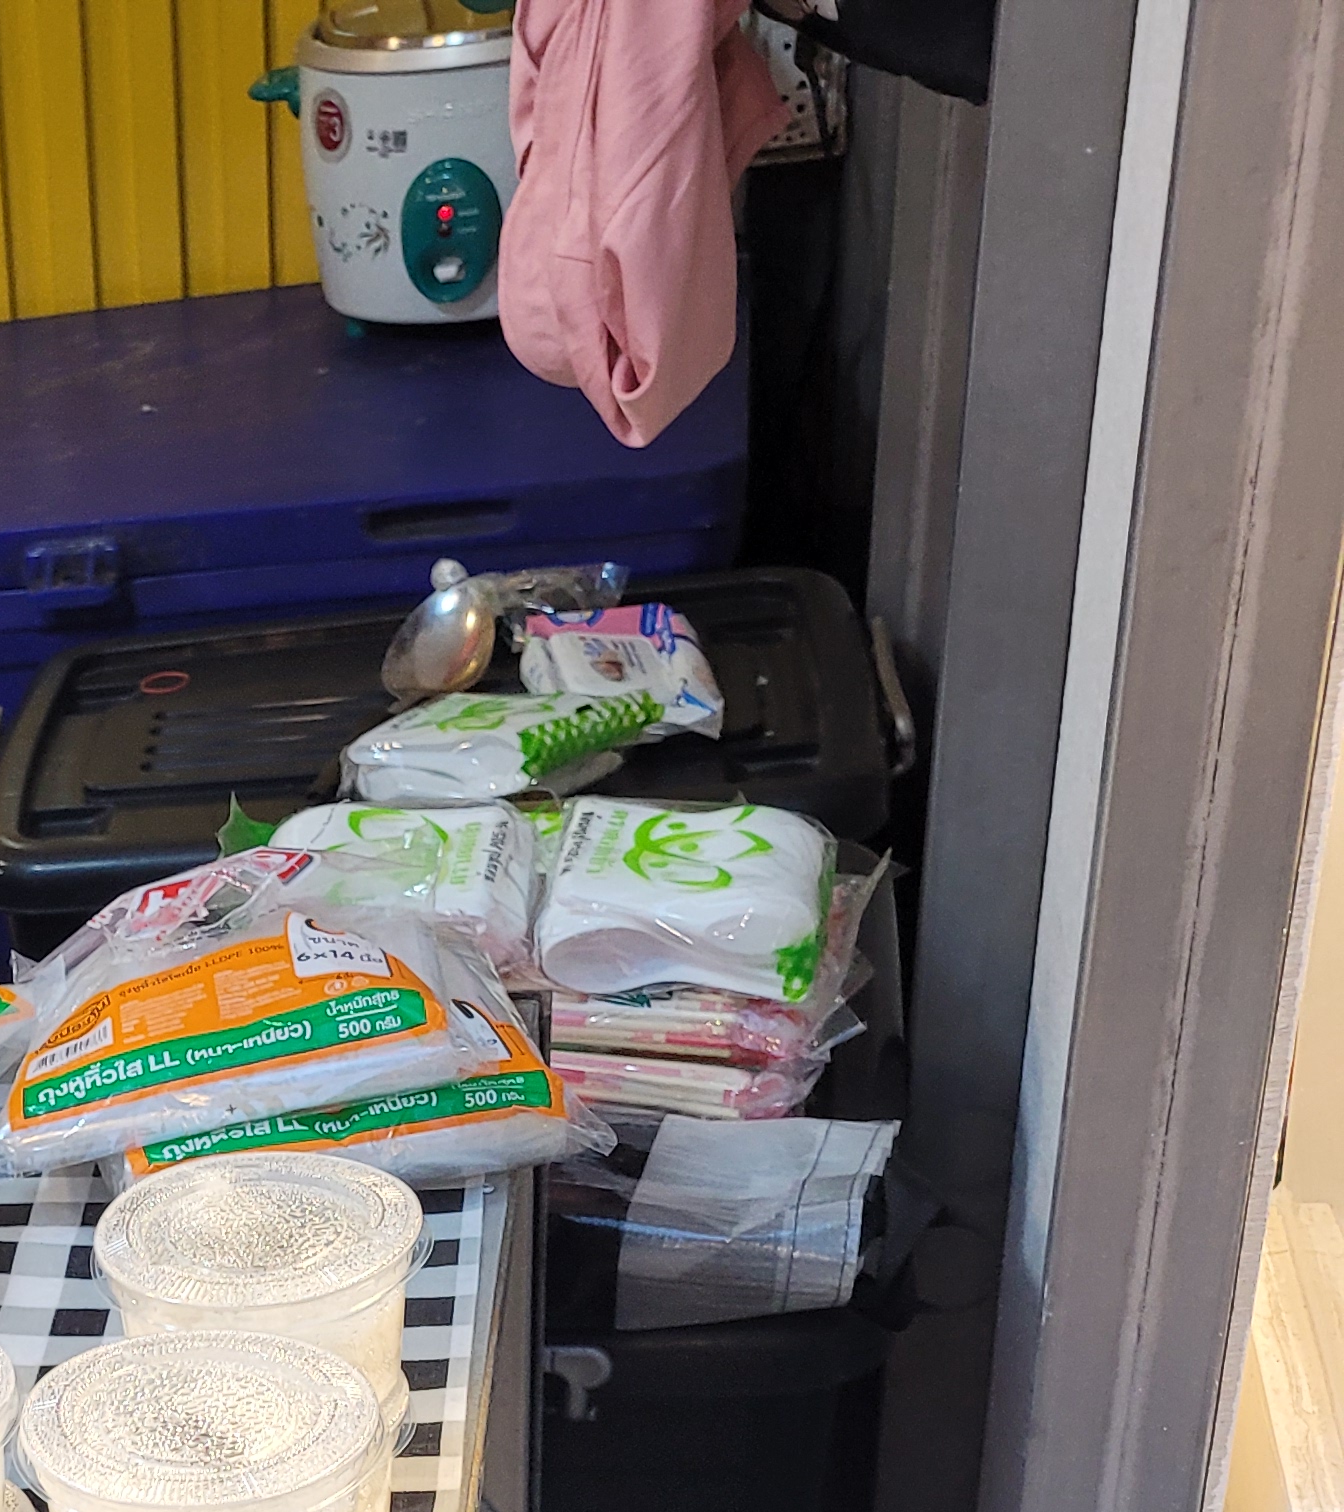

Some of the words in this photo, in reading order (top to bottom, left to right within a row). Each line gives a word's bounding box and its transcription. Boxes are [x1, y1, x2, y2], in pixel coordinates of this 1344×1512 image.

[338, 1018, 372, 1039] 500
[147, 1050, 181, 1072] LL
[464, 1089, 498, 1108] 500
